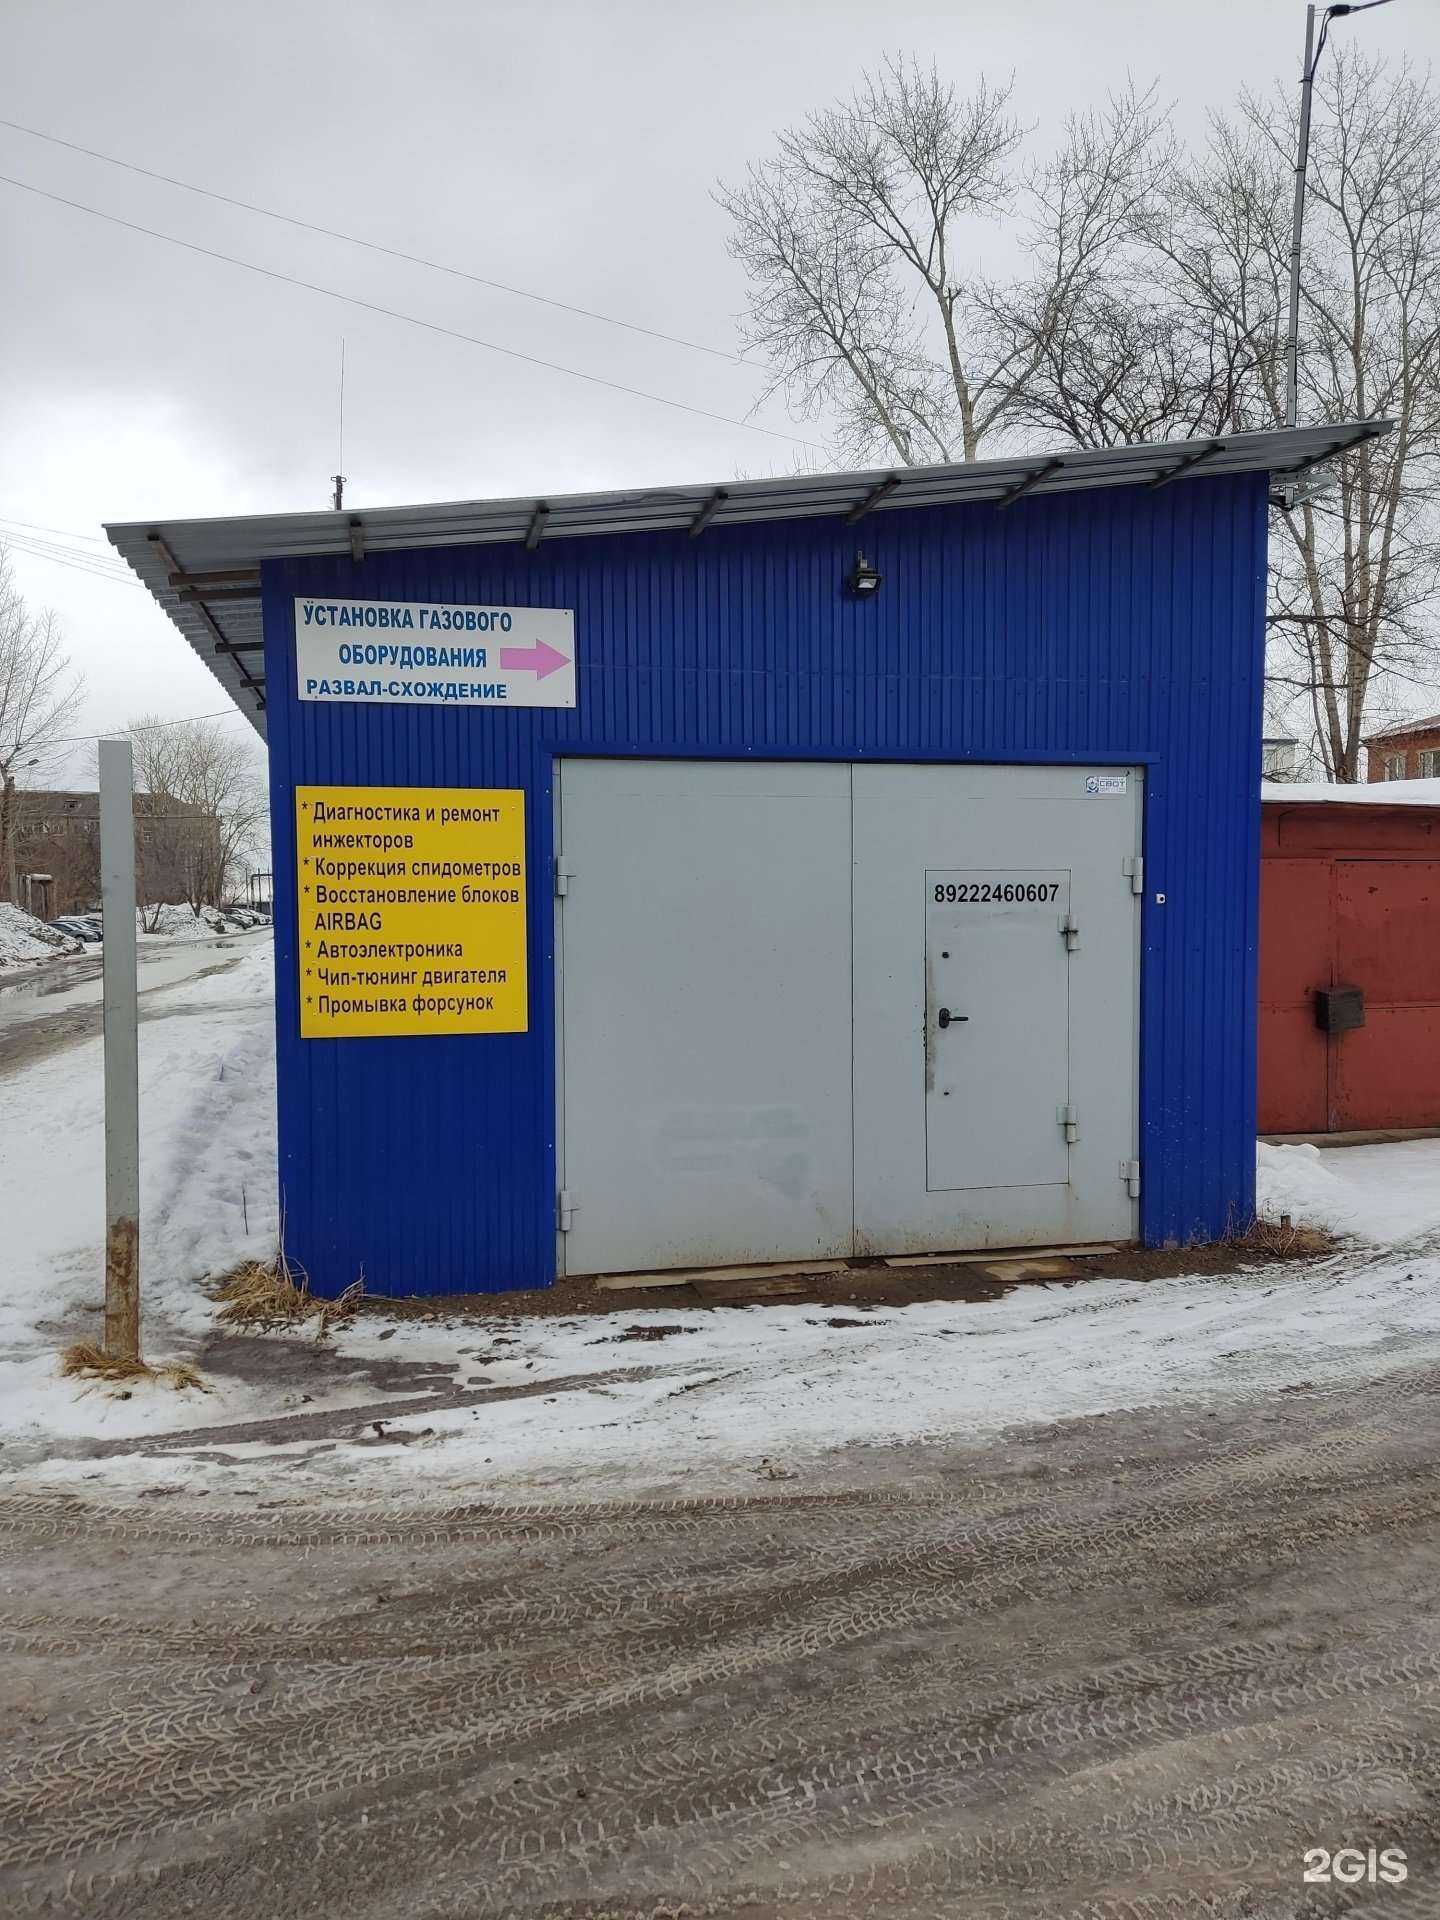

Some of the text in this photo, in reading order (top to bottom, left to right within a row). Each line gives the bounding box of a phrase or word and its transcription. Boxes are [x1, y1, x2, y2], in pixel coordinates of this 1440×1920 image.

[303, 604, 512, 632] УСТАНОВКА ГАЗОВОГО
[338, 643, 487, 669] ОБОРУДОВАНИЯ
[306, 679, 507, 700] РАЗВАЛ-СХОЖДЕНИЕ
[313, 801, 500, 825] Диагностика и ремонт
[312, 833, 414, 852] инжекторов
[315, 858, 521, 880] Коррекция спидометров
[316, 885, 519, 904] Восстановление блоков
[934, 884, 1059, 903] 89222460607
[314, 912, 382, 931] AIRBAG
[317, 940, 463, 961] Автоэлектроника
[317, 967, 507, 987] Чип-тюнинг двигателя
[318, 994, 494, 1017] Промывка форсунок
